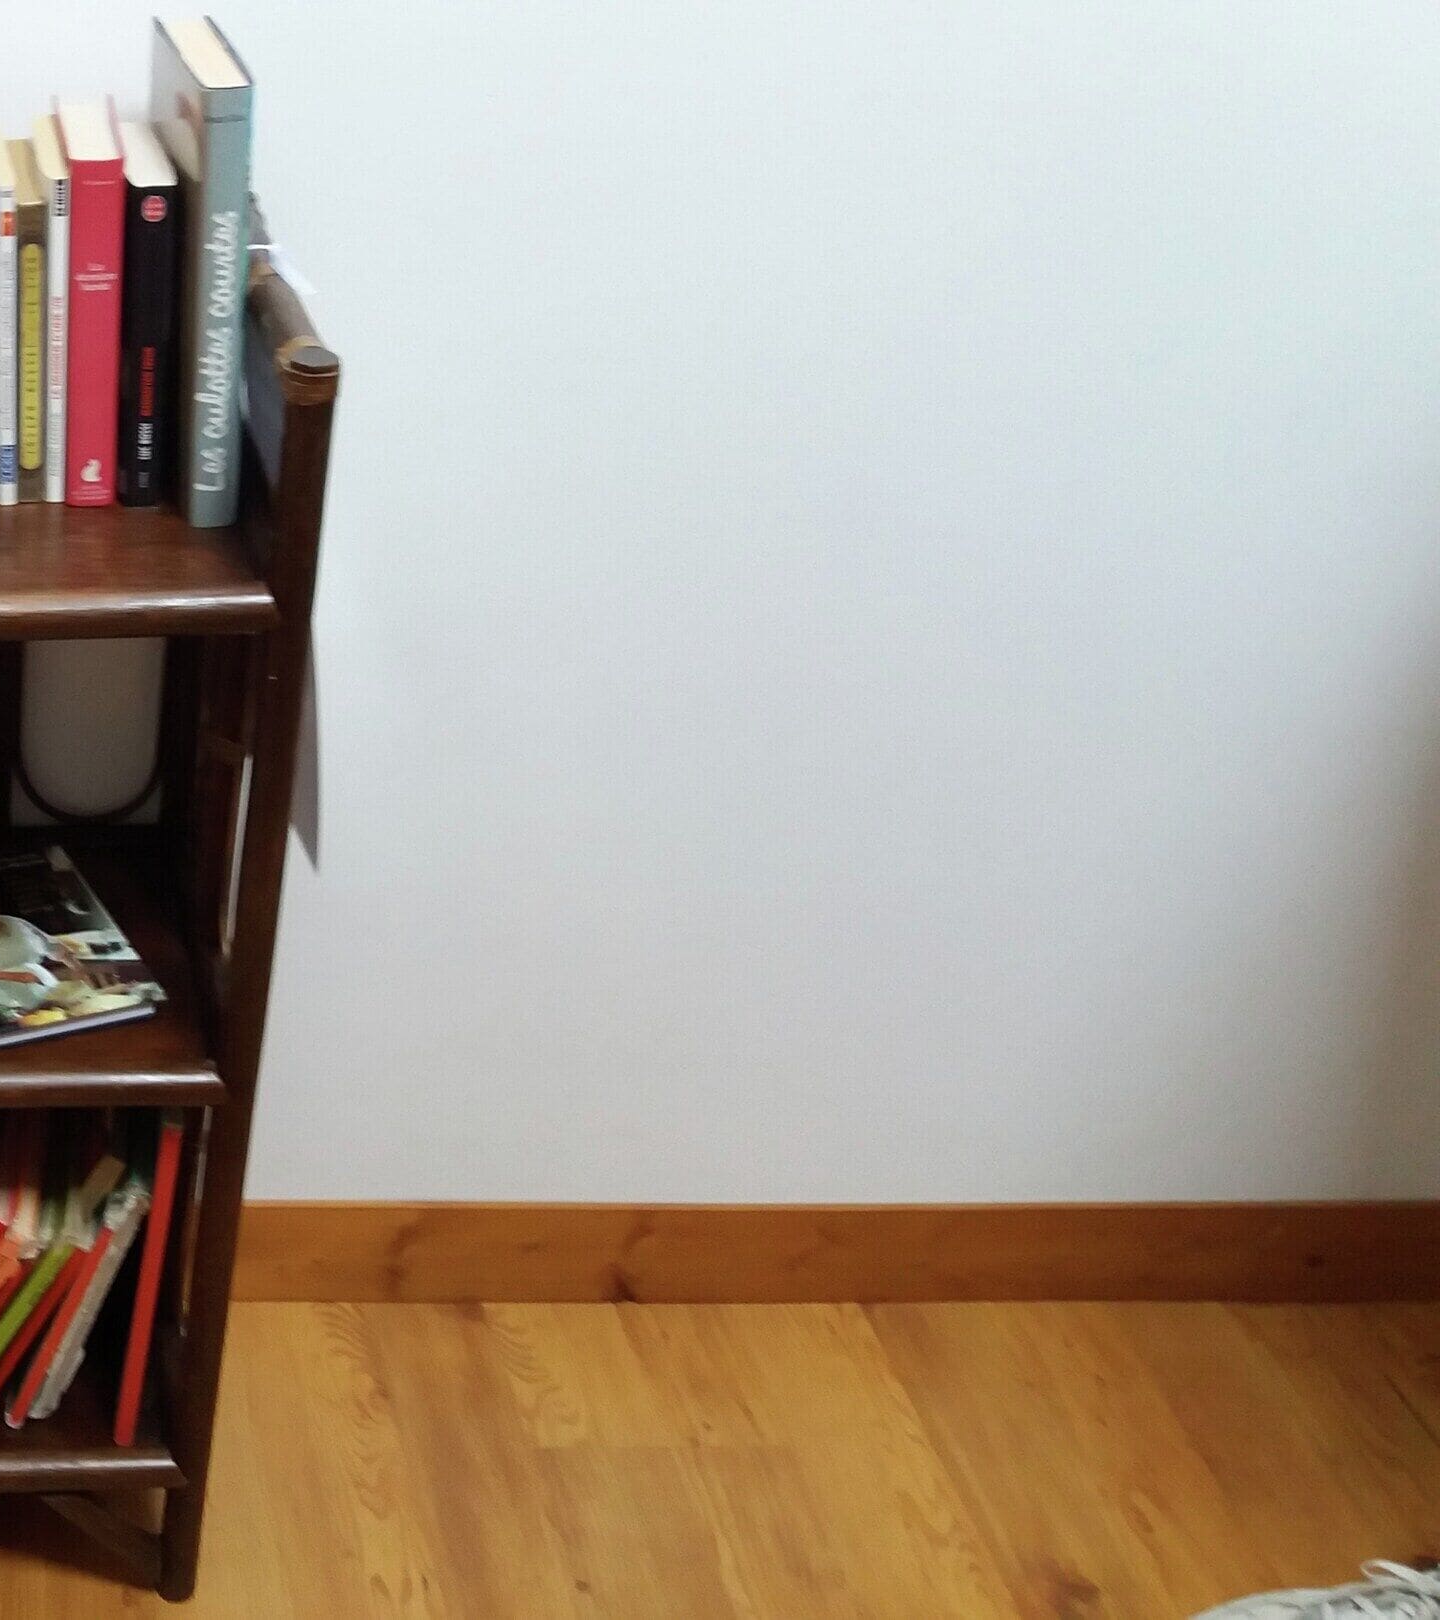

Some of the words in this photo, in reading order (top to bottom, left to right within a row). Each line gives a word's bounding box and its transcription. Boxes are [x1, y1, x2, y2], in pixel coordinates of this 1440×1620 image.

[203, 210, 240, 318] courtes
[193, 326, 233, 439] culottes
[192, 447, 228, 492] Les
